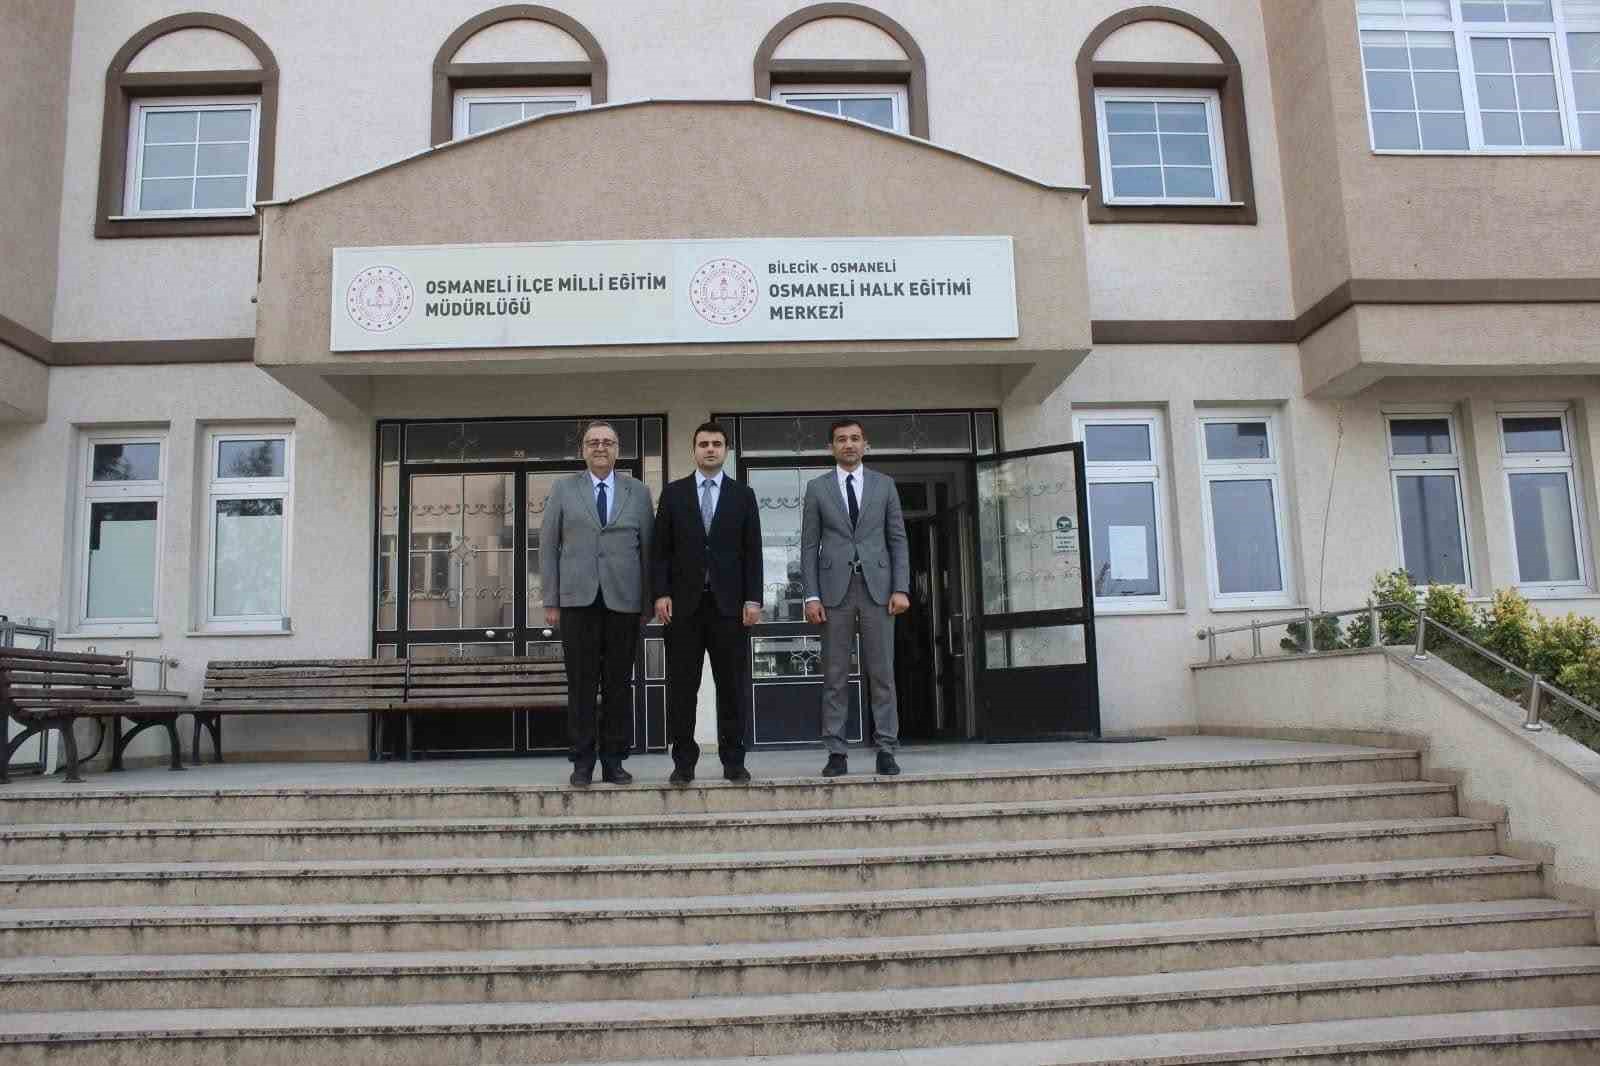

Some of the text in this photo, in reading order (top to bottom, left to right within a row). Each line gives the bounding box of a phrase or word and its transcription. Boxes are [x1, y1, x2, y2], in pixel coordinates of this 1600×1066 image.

[768, 260, 819, 274] BİLECİK
[830, 259, 897, 274] OSMANELİ
[425, 272, 666, 295] OSMANELİ İLÇE MİLLİ EĞİTİM
[769, 279, 855, 298] OSMANELİ
[859, 282, 905, 297] HALK
[909, 277, 971, 297] EĞİTİMİ
[425, 297, 531, 317] MÜDÜRLÜĞÜ
[769, 301, 844, 320] MERKEZİ
